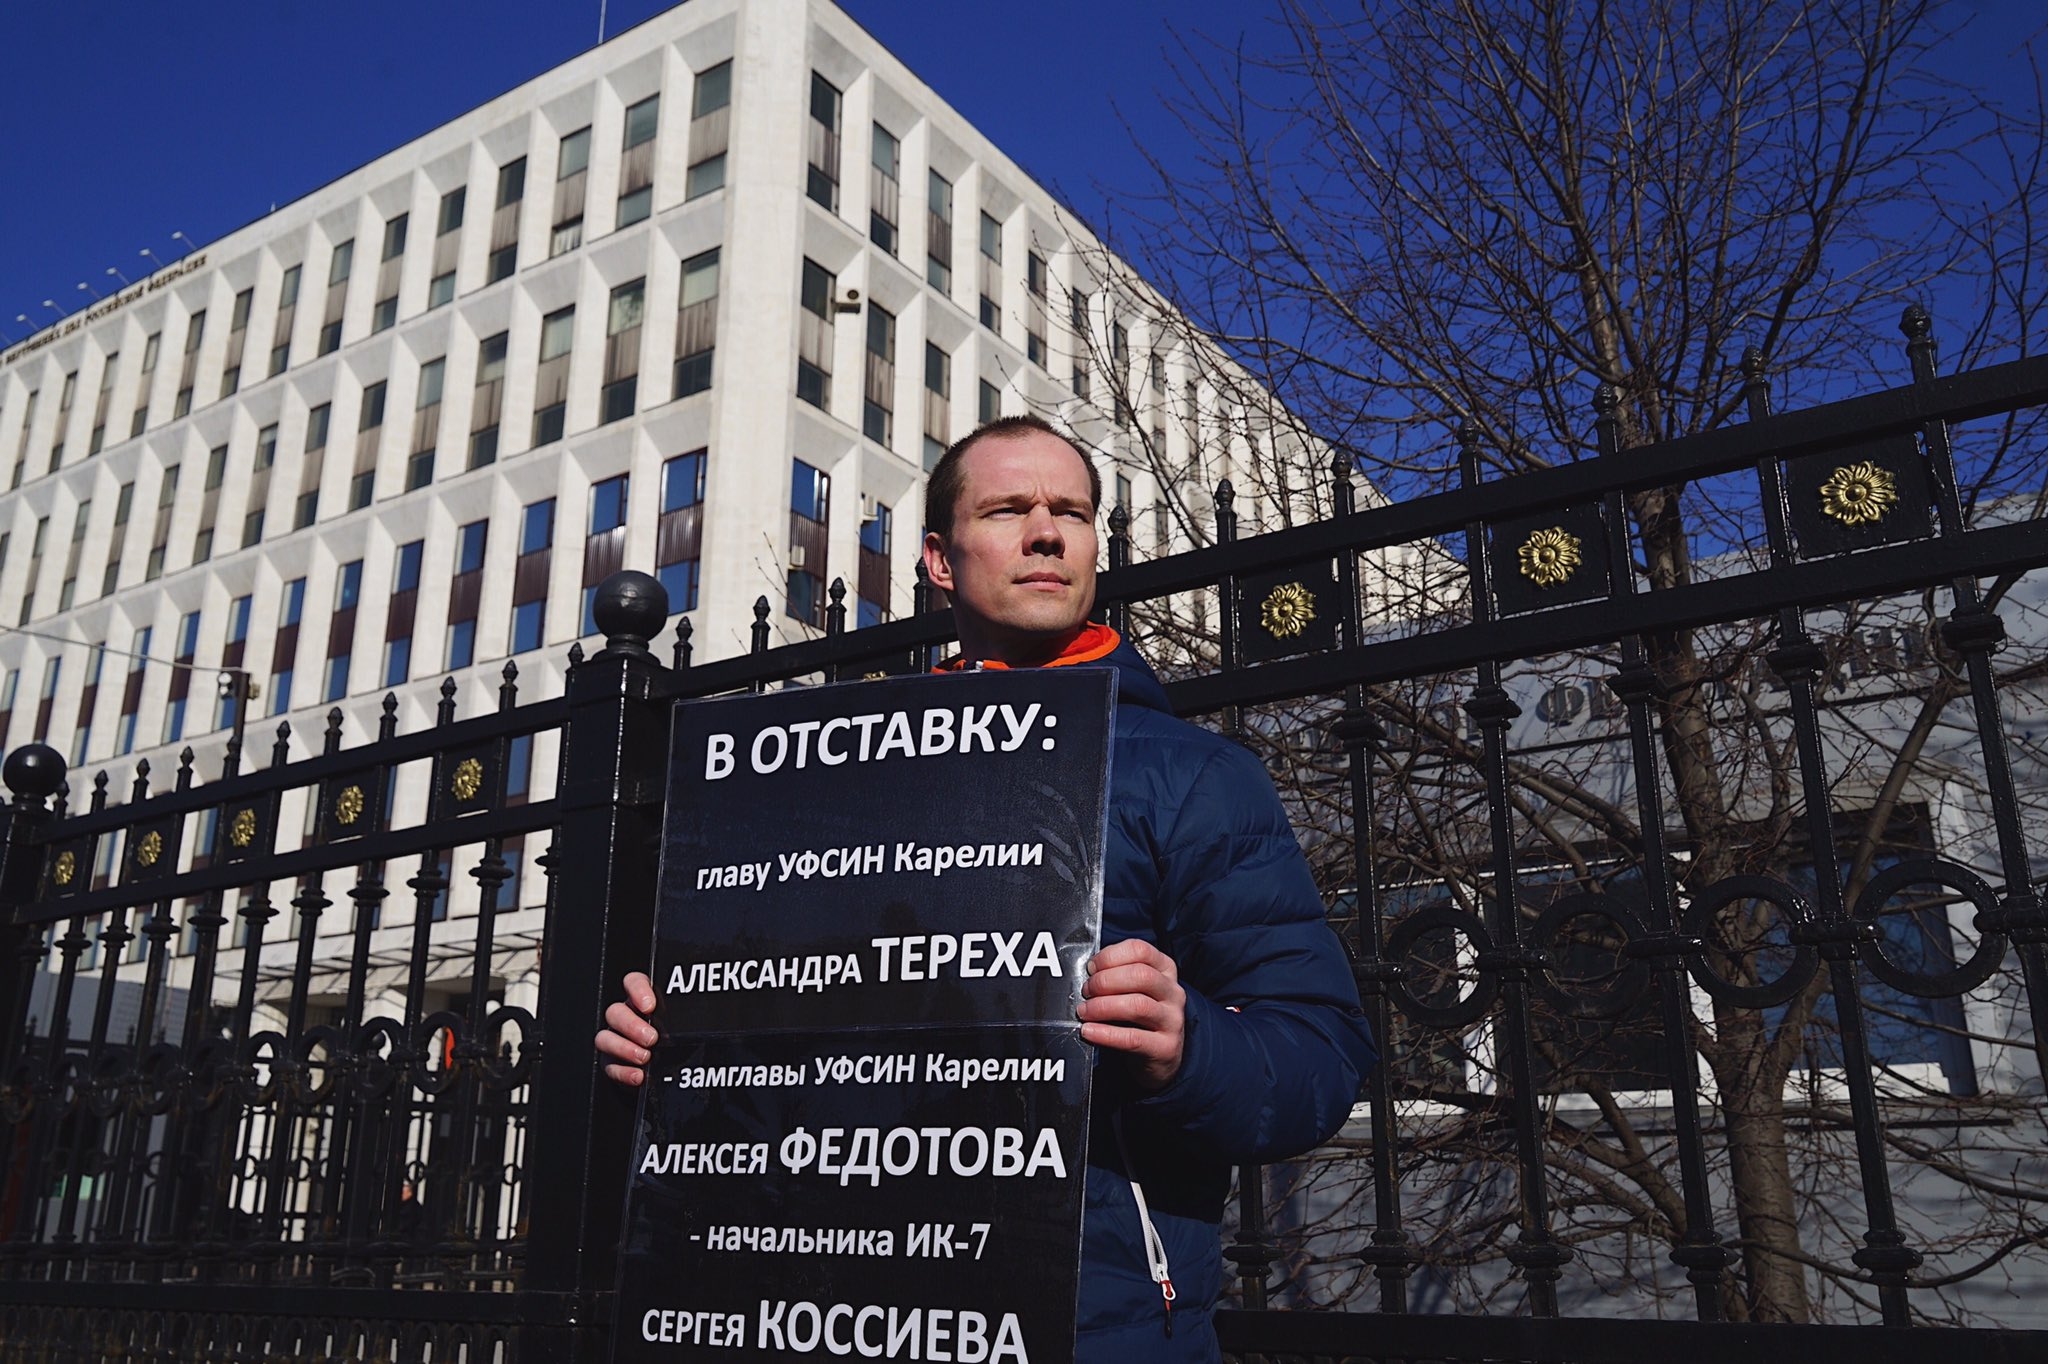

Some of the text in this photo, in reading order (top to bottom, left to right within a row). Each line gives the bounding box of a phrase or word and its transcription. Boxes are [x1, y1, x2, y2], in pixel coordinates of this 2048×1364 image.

[705, 703, 1057, 781] В ОТСТАВКУ:
[696, 842, 1043, 891] главу УФСИН Карелии
[666, 931, 1063, 995] АЛЕКСАНДРА ТЕРЕХА
[679, 1064, 806, 1089] замглавы
[814, 1054, 916, 1085] УФСИН
[925, 1053, 1065, 1089] Карелии
[639, 1126, 1067, 1187] АЛЕКСЕЯ ФЕДОТОВА
[707, 1225, 894, 1257] начальника
[906, 1222, 991, 1260] ИК-7
[642, 1299, 1029, 1364] СЕРГЕЯ КОССИЕВА
